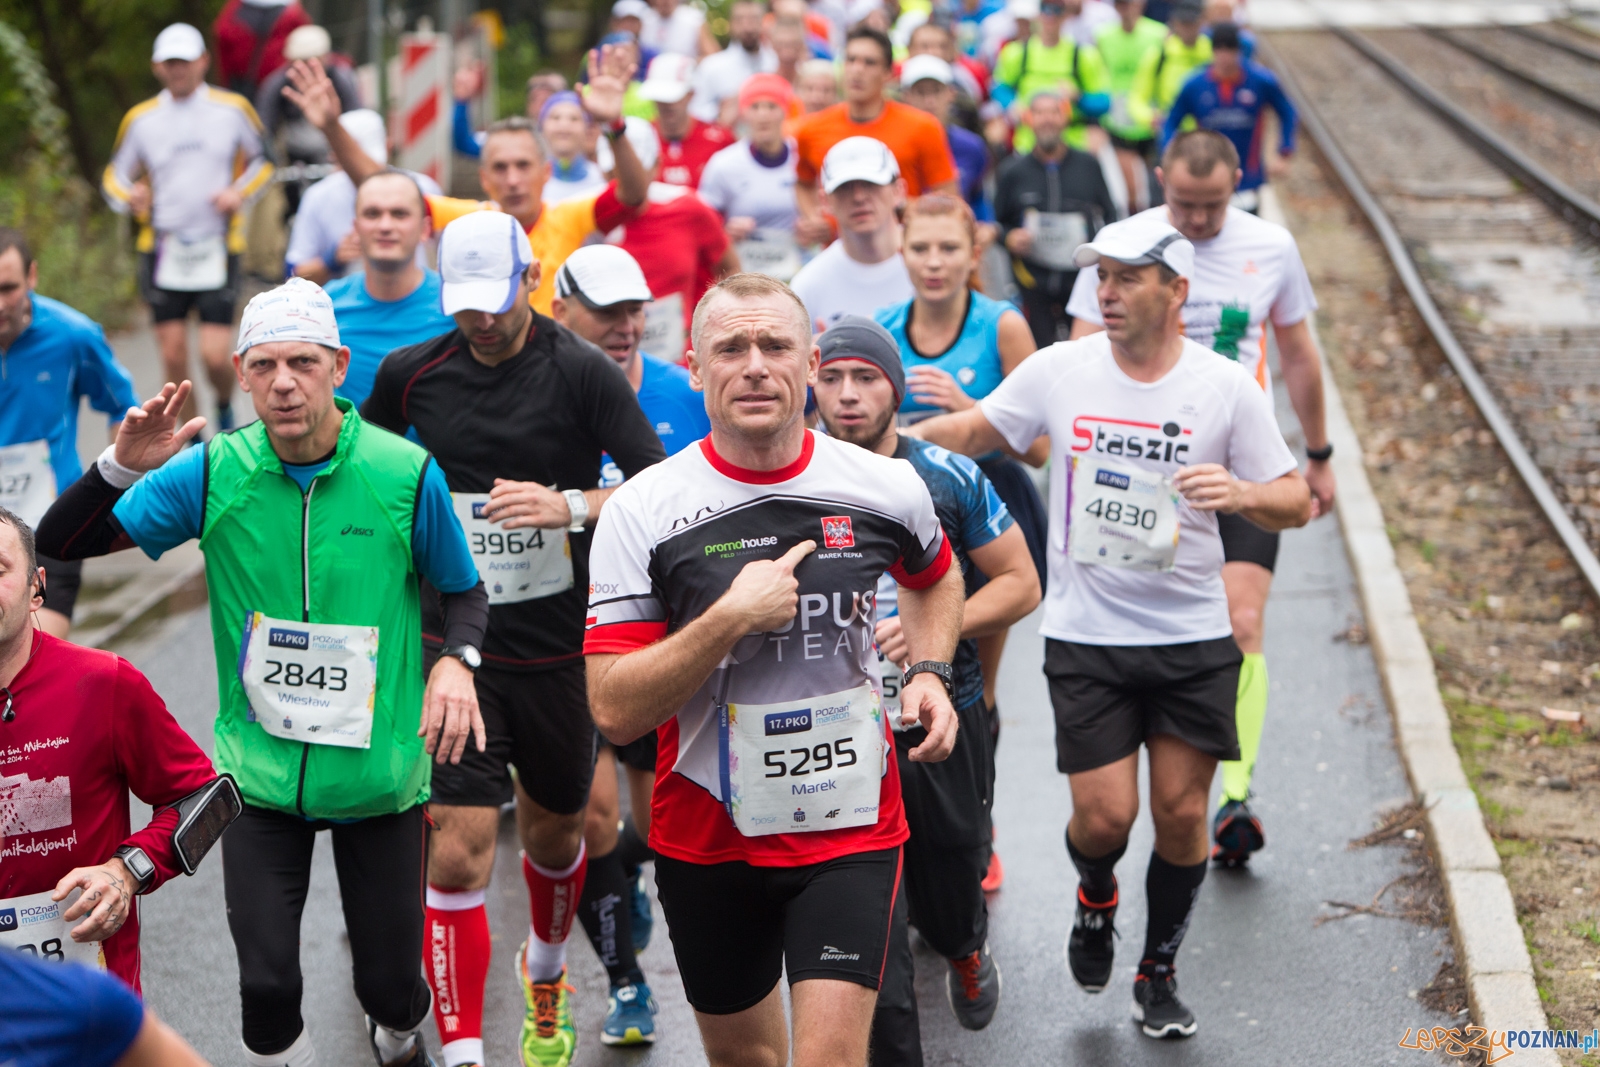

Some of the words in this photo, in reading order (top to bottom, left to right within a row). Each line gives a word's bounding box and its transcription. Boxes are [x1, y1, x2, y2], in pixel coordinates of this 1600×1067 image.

[1071, 415, 1192, 465] Staszic
[0, 473, 31, 494] 27
[1085, 498, 1157, 530] 4830
[472, 528, 544, 554] 3964
[704, 535, 778, 556] promohouse
[488, 560, 530, 571] Andrzej
[264, 660, 347, 691] 2843
[278, 692, 330, 708] Wiesław
[815, 711, 850, 725] maraton
[24, 736, 70, 753] Mikołajów
[7, 755, 23, 764] 2014
[764, 737, 857, 778] 5295
[792, 779, 836, 795] Marek
[0, 829, 77, 858] mikolajow.pl
[22, 909, 60, 924] maraton
